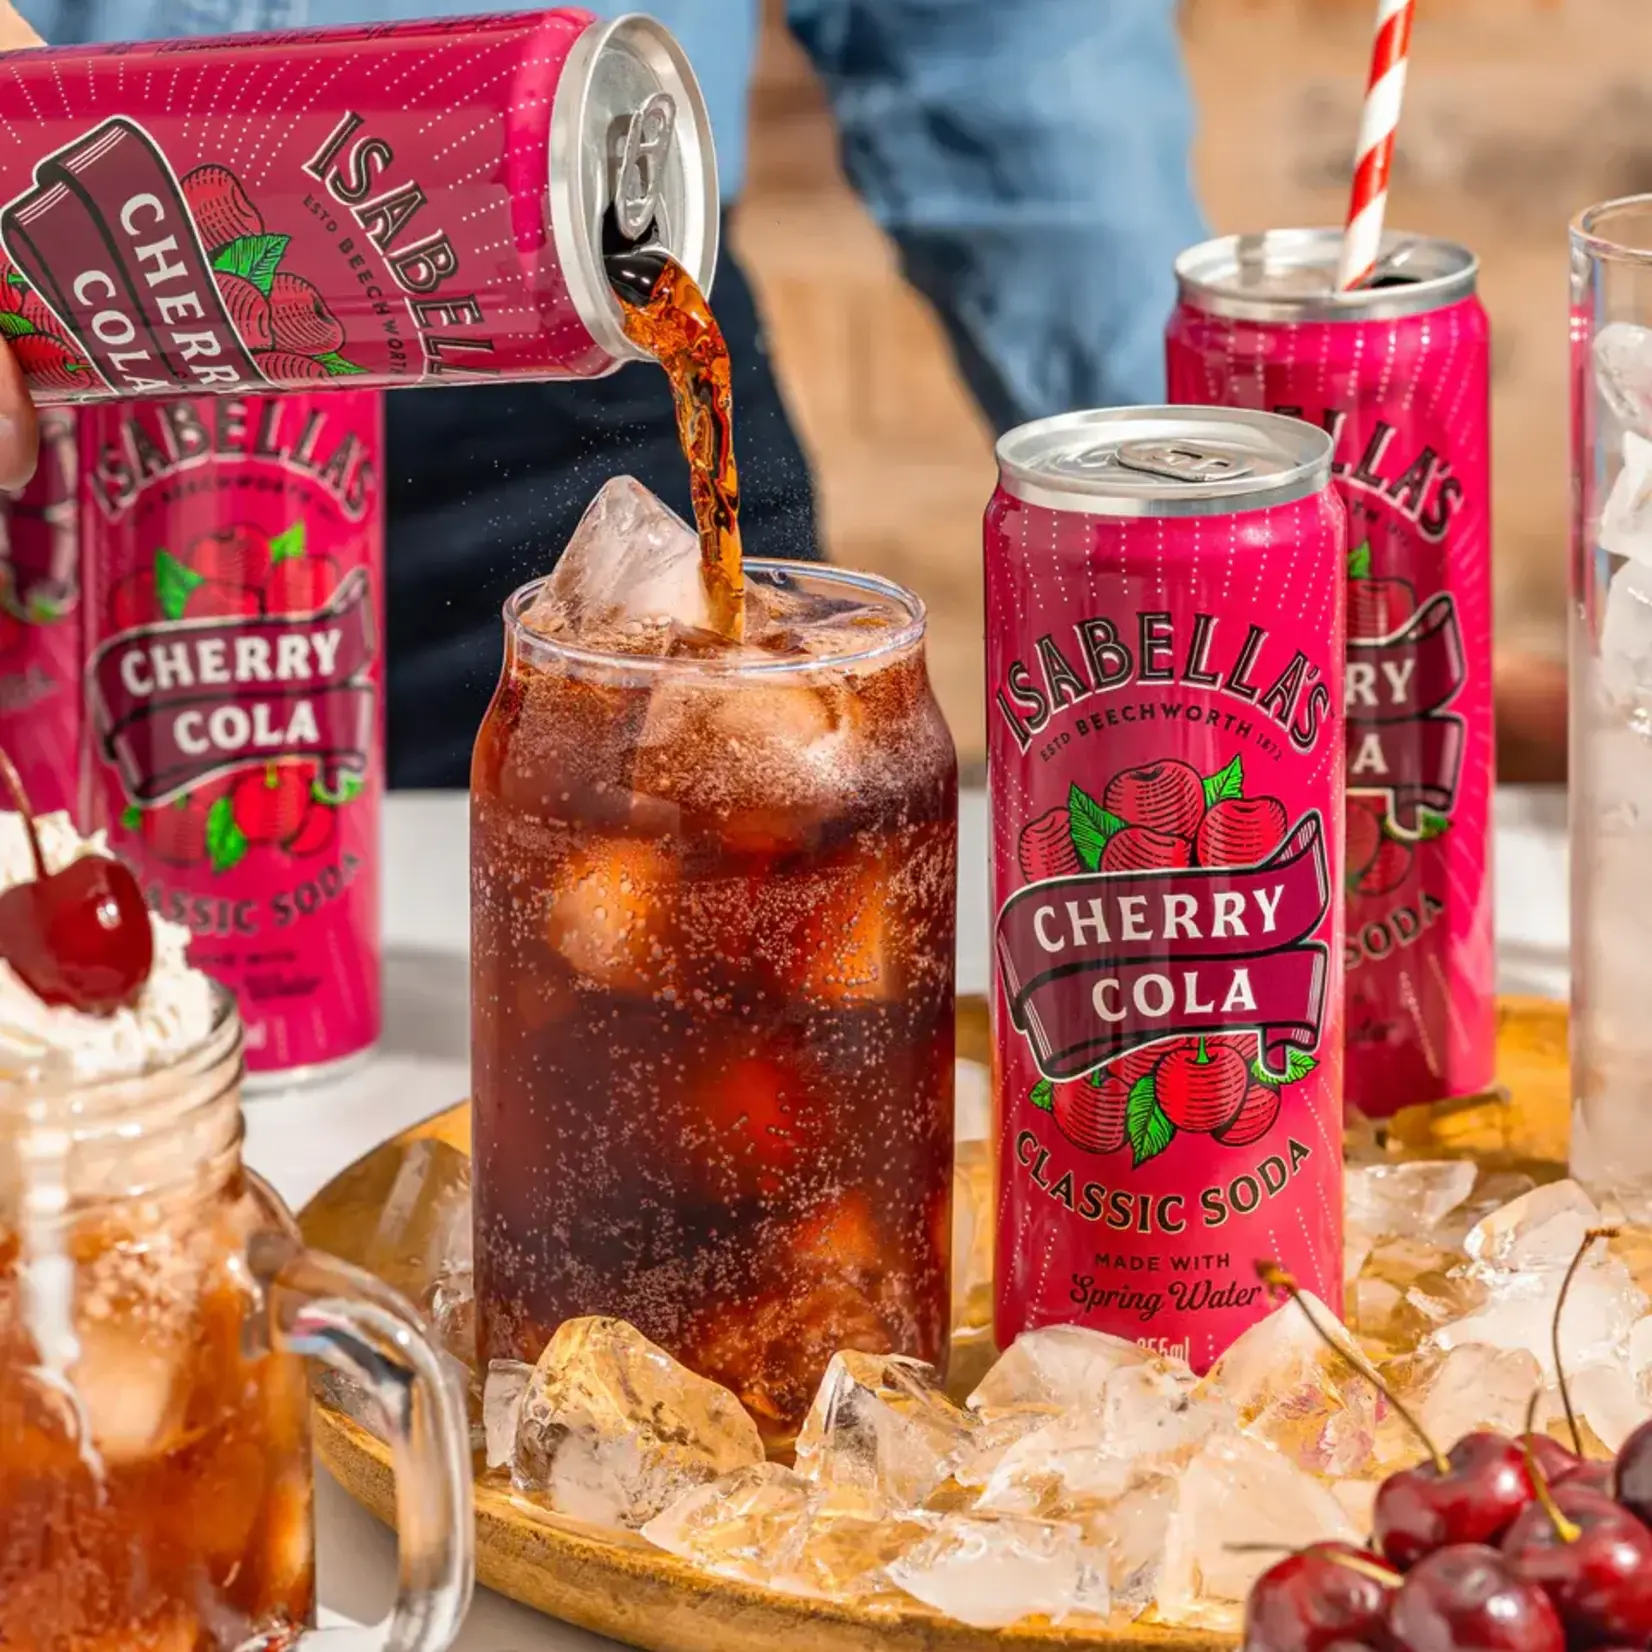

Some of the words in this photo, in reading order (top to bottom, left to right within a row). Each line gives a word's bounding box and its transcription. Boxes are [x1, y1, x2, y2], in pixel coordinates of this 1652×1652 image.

[302, 193, 338, 233] ESTD
[120, 193, 253, 394] CHERR
[73, 270, 172, 392] COLA
[1274, 406, 1464, 543] LLA'S
[120, 629, 344, 697] CHERRY
[996, 611, 1331, 756] ISABELLA'S
[173, 702, 320, 755] COLA
[1040, 732, 1071, 762] ESTD
[1075, 703, 1254, 739] BEECHWORTH
[1255, 733, 1283, 762] 1872
[130, 862, 258, 935] ASSIC
[270, 853, 362, 927] SODA
[1033, 884, 1285, 953] CHERRY
[1092, 968, 1258, 1022] COLA
[1015, 1128, 1187, 1234] CLASSIC
[1200, 1136, 1313, 1228] SODA
[1095, 1253, 1160, 1272] MADE
[1170, 1252, 1231, 1272] WITH
[1069, 1272, 1164, 1321] Spring
[1168, 1279, 1262, 1311] Water
